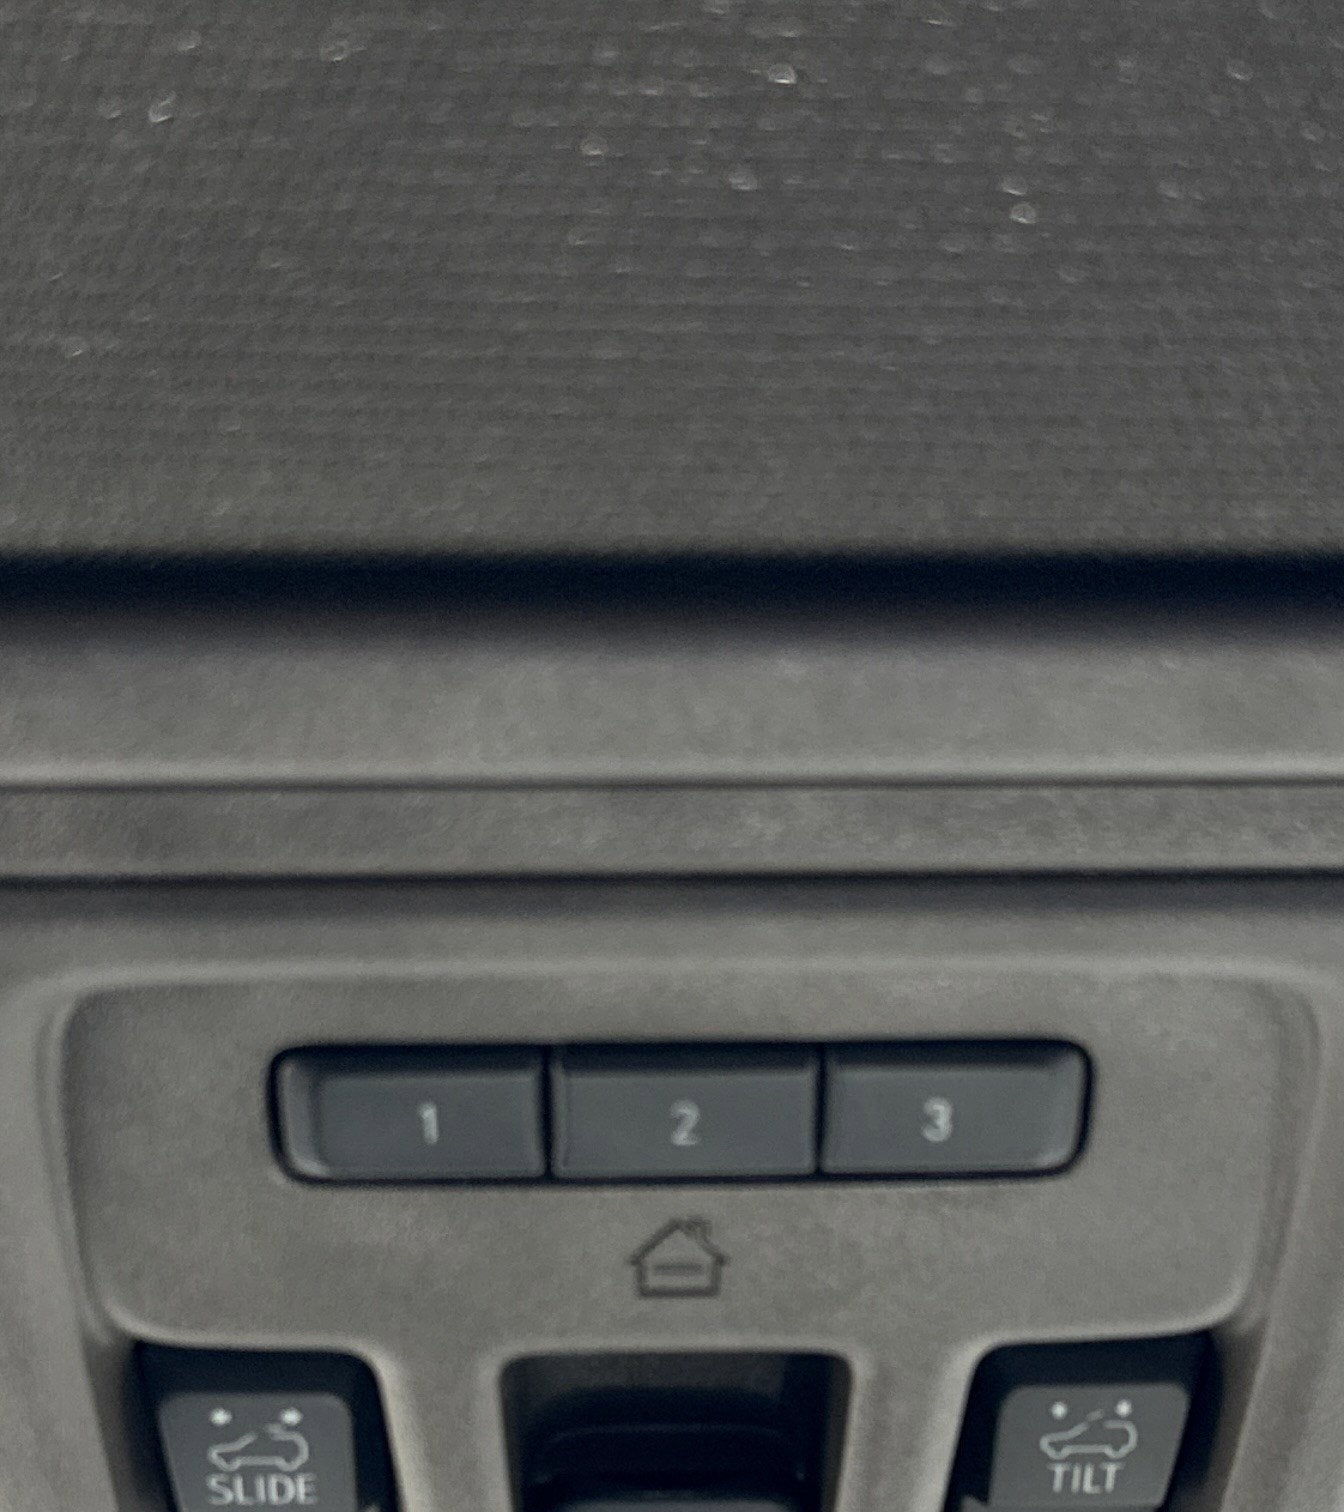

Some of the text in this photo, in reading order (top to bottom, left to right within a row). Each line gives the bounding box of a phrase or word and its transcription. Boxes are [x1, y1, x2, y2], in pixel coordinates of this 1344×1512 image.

[417, 1101, 440, 1145] 1
[669, 1099, 701, 1147] 2
[921, 1096, 954, 1142] 3
[207, 1472, 318, 1506] SLIDE
[1047, 1461, 1125, 1495] TILT
